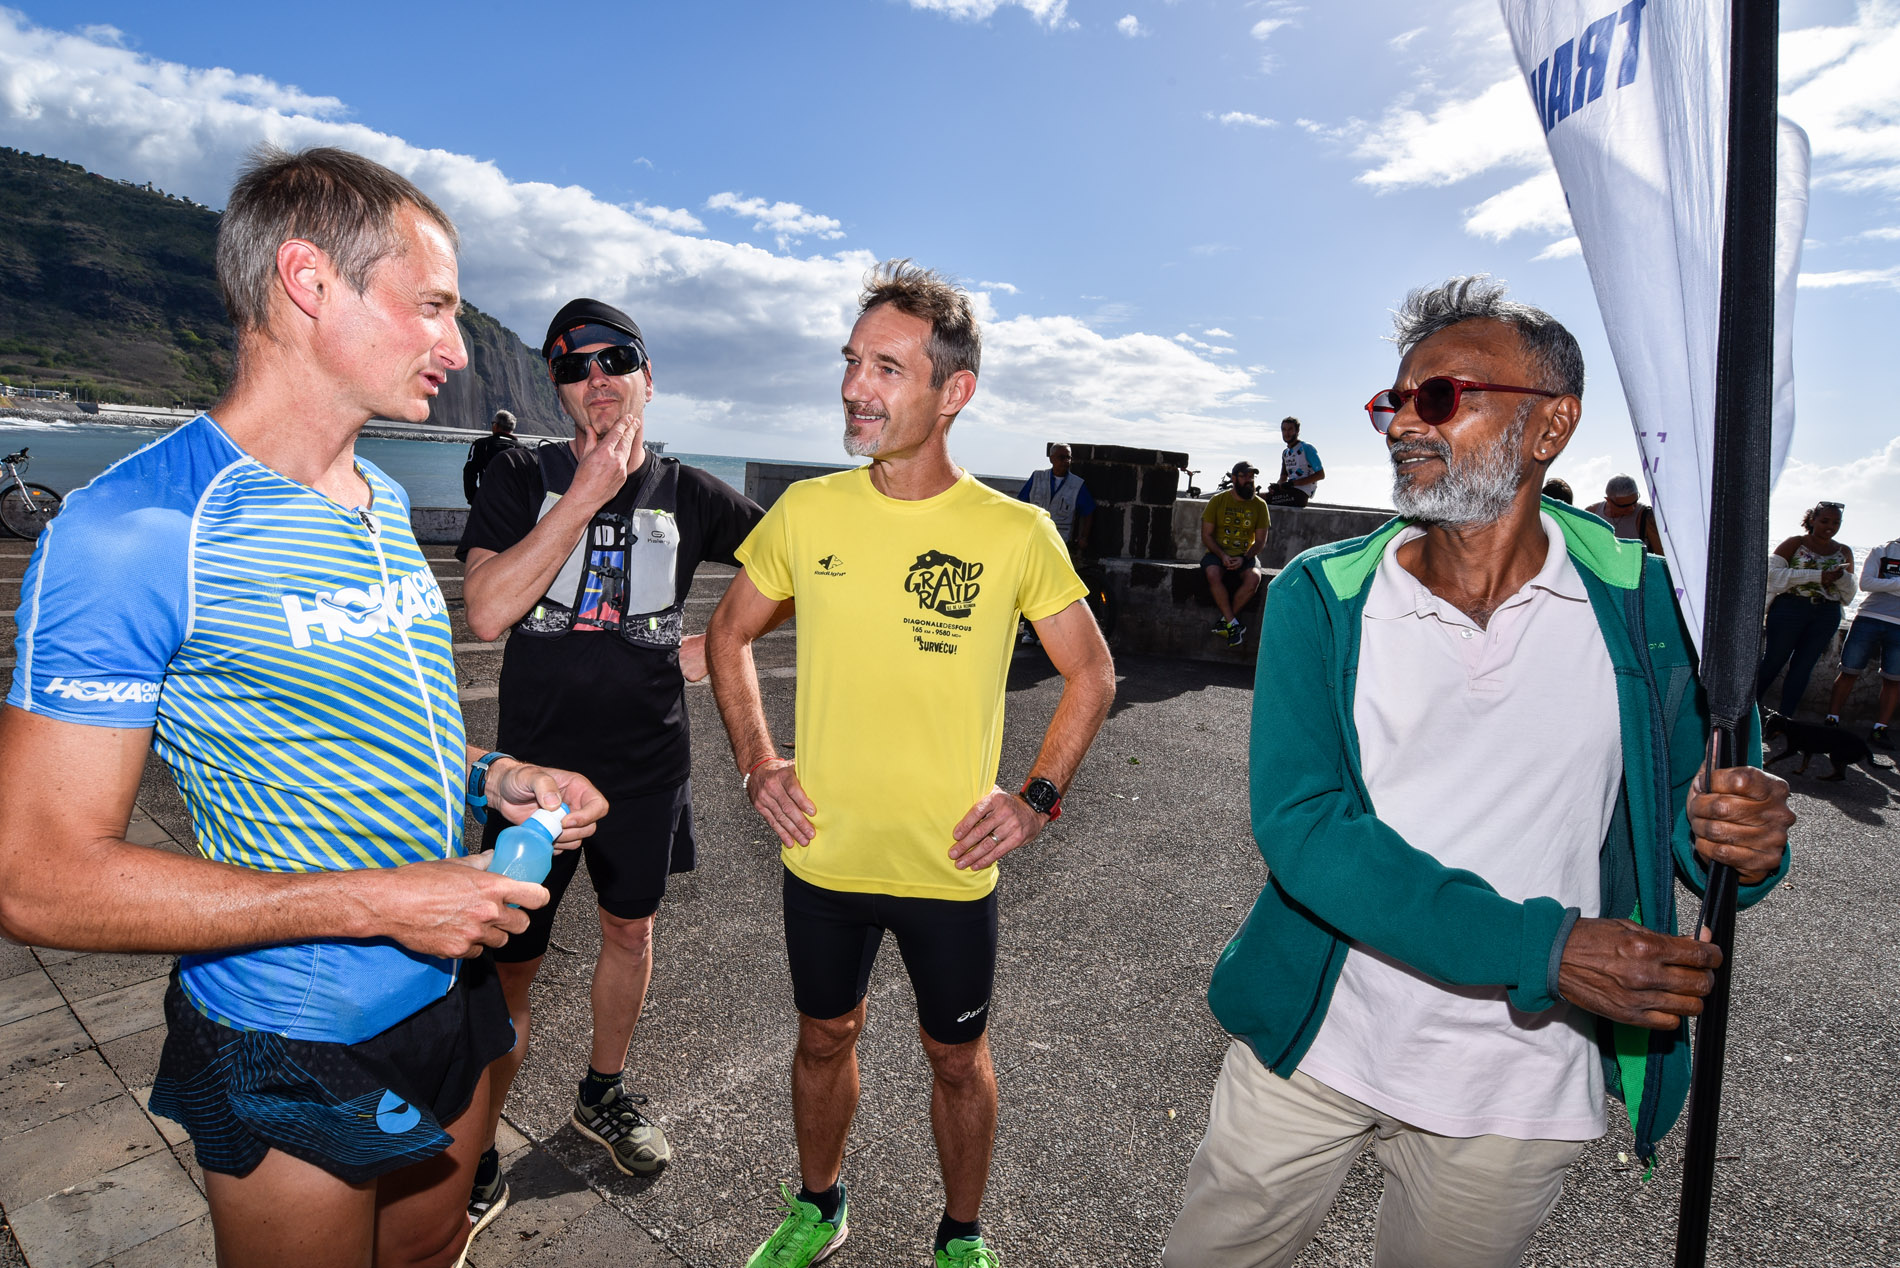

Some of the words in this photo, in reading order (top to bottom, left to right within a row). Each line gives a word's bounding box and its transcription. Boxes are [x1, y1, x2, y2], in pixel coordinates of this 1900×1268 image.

[411, 565, 438, 594] ON
[904, 562, 984, 609] GRAND
[281, 576, 432, 649] HOKA
[935, 629, 951, 637] 9580
[44, 677, 141, 703] HOKA
